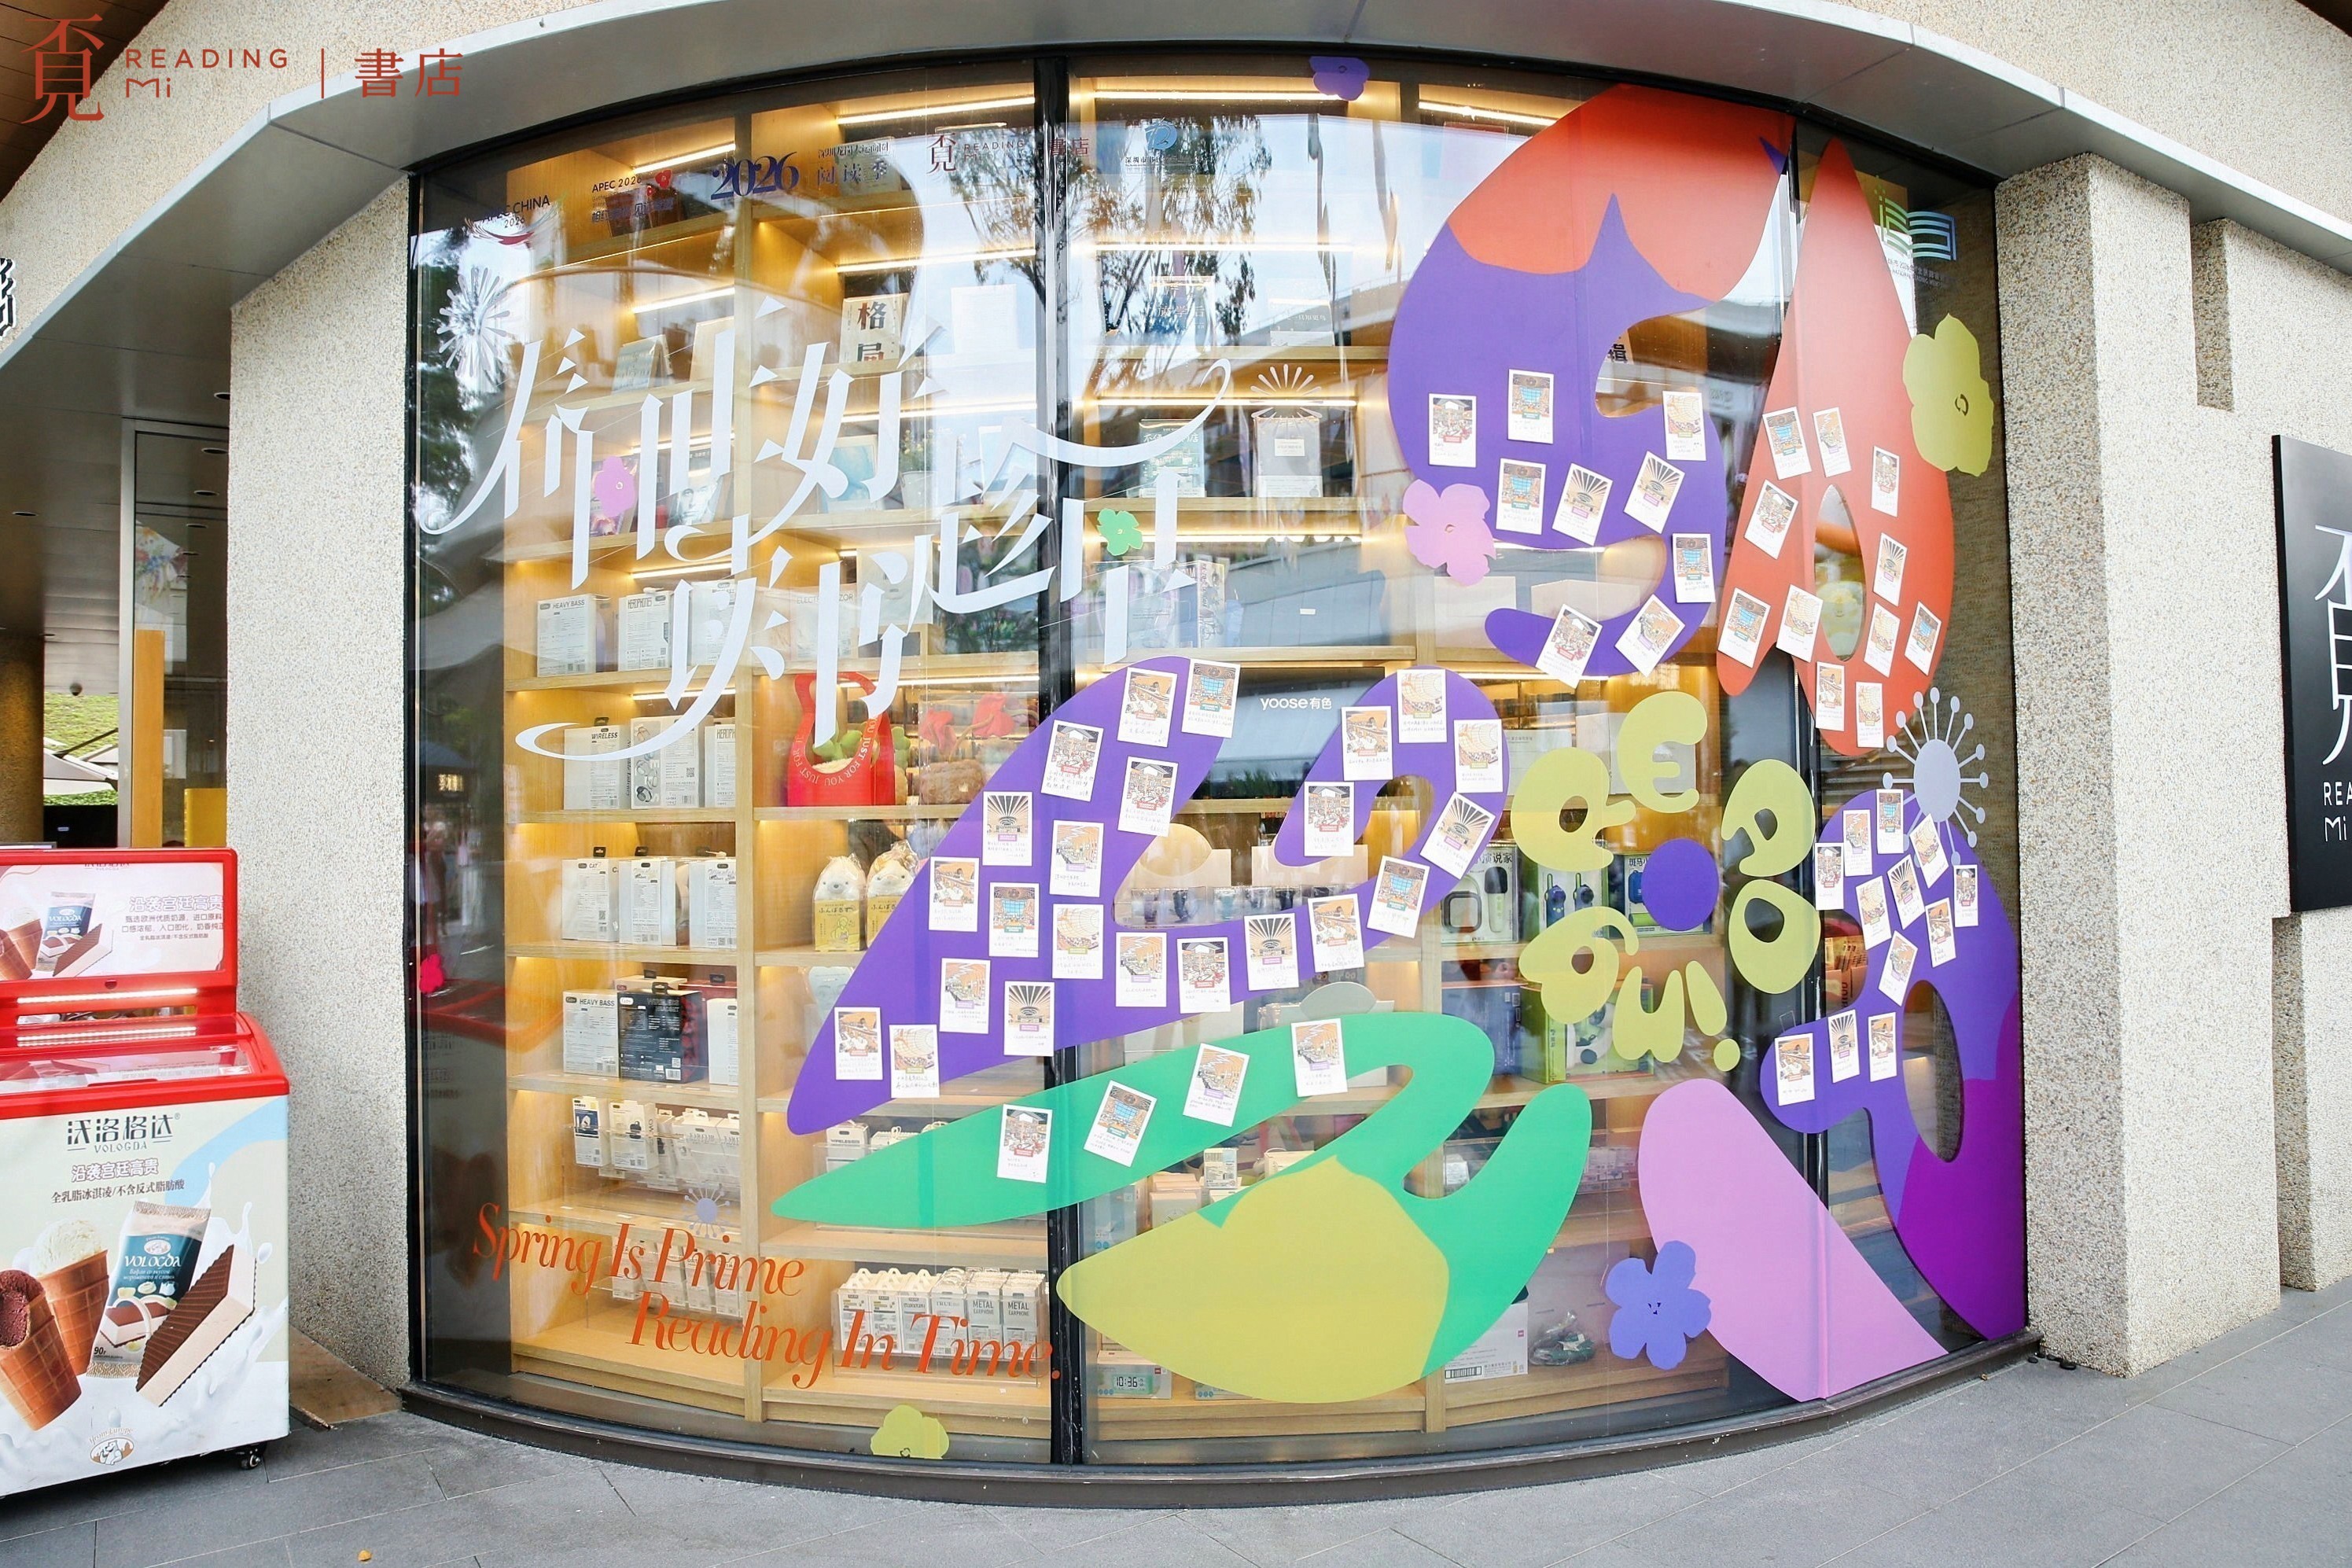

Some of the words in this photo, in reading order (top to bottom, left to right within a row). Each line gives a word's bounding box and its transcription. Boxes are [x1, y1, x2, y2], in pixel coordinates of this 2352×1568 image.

[963, 141, 1025, 152] READING
[591, 180, 617, 193] APEC
[617, 175, 642, 188] 2026
[710, 151, 800, 201] 2026
[512, 194, 550, 214] CHINA
[1260, 698, 1309, 711] yoose
[1309, 697, 1332, 709] 有色
[591, 731, 618, 740] WIRELESS
[67, 1114, 173, 1145] 沃洛格达
[94, 1141, 148, 1154] VOLOGDA
[71, 1158, 159, 1183] 沿袭宫廷高贵
[473, 1202, 602, 1295] Spring
[605, 1222, 645, 1281] Is
[649, 1227, 804, 1296] Prime
[624, 1290, 832, 1389] Reading
[835, 1309, 896, 1371] In
[910, 1313, 1061, 1378] Time.
[1117, 1377, 1137, 1387] 10:36
